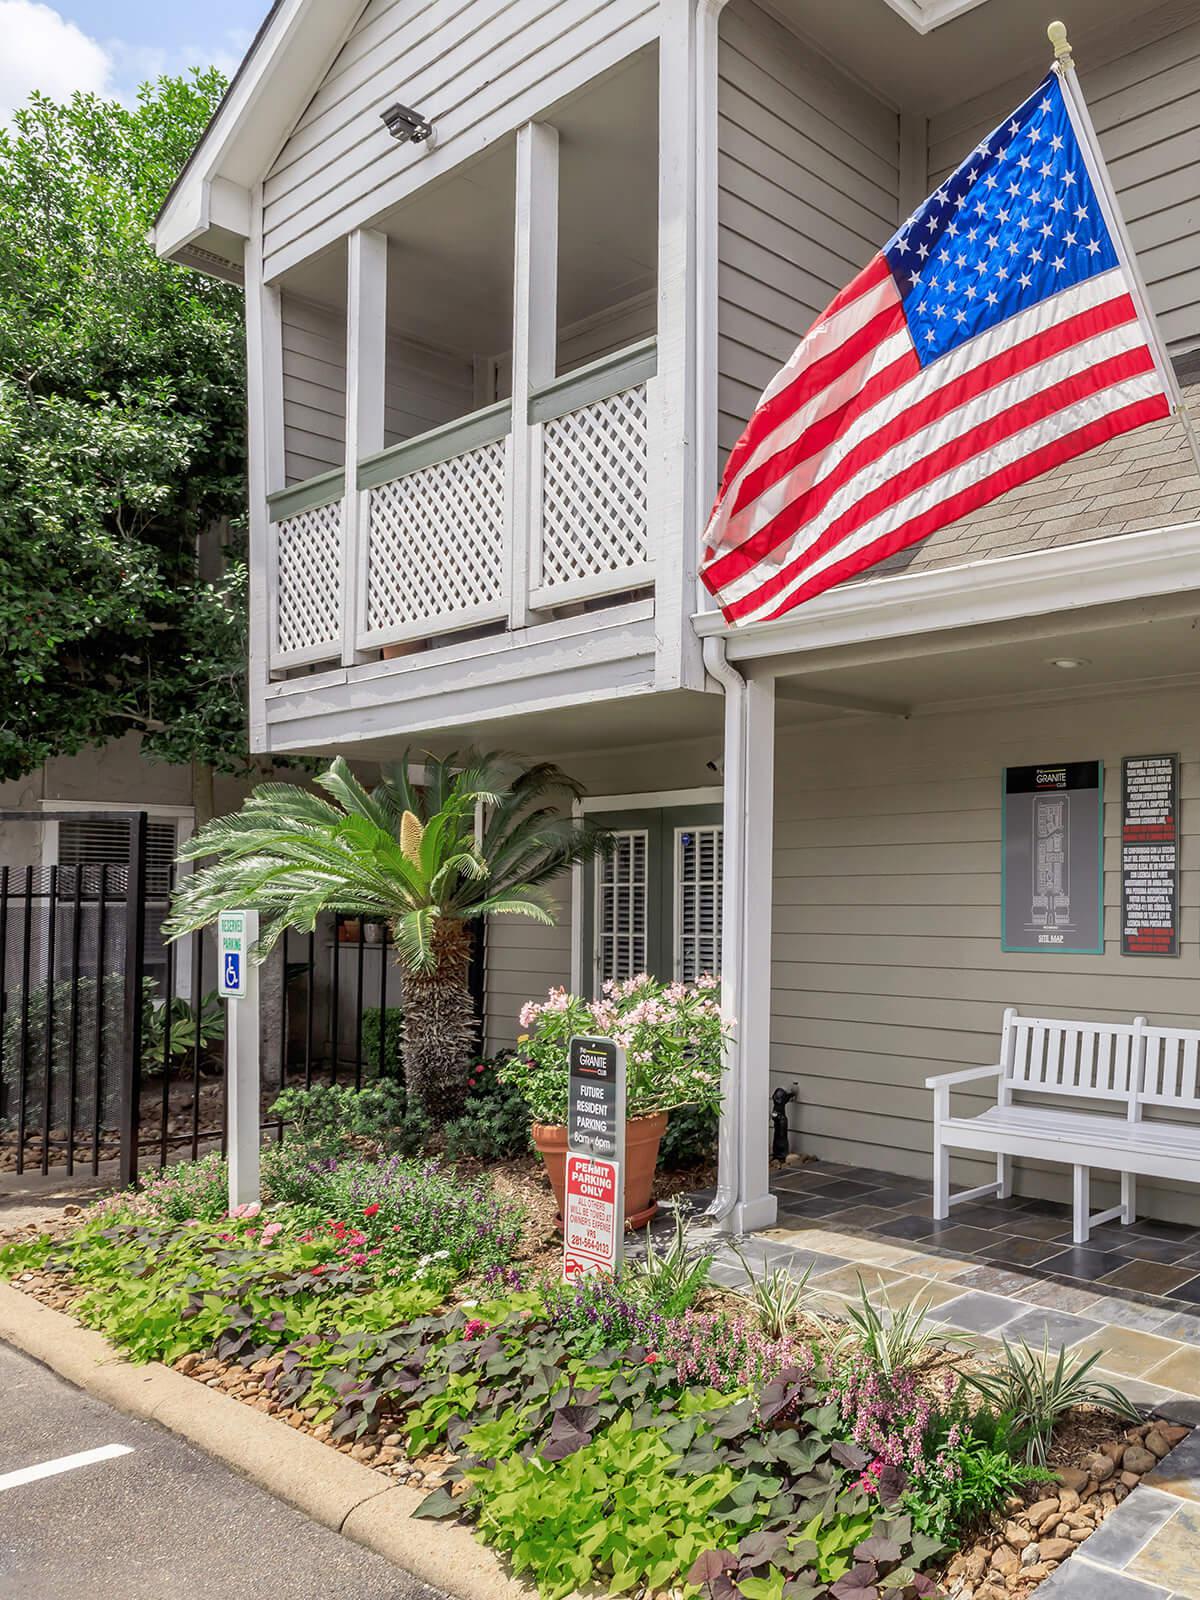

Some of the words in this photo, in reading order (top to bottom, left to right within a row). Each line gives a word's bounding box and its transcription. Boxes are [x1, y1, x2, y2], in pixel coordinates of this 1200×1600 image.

[1036, 772, 1067, 784] GRANITE
[221, 920, 242, 932] RESERVED
[224, 937, 241, 951] PARKING
[1038, 934, 1050, 943] SITE
[1050, 935, 1064, 944] MAP
[580, 1054, 607, 1068] GRANITE
[580, 1085, 604, 1099] FUTURE
[576, 1100, 608, 1116] RESIDENT
[577, 1115, 607, 1132] PARKING
[594, 1135, 611, 1151] 6pm
[575, 1162, 609, 1177] PERMIT
[572, 1171, 611, 1189] PARKING
[580, 1184, 603, 1197] ONLY
[578, 1197, 587, 1207] ALL
[587, 1199, 606, 1212] OTHERS
[570, 1204, 582, 1215] WILL
[583, 1207, 589, 1217] BE
[589, 1209, 605, 1221] TOWED
[606, 1214, 612, 1223] AT
[592, 1219, 611, 1233] EXPENSE
